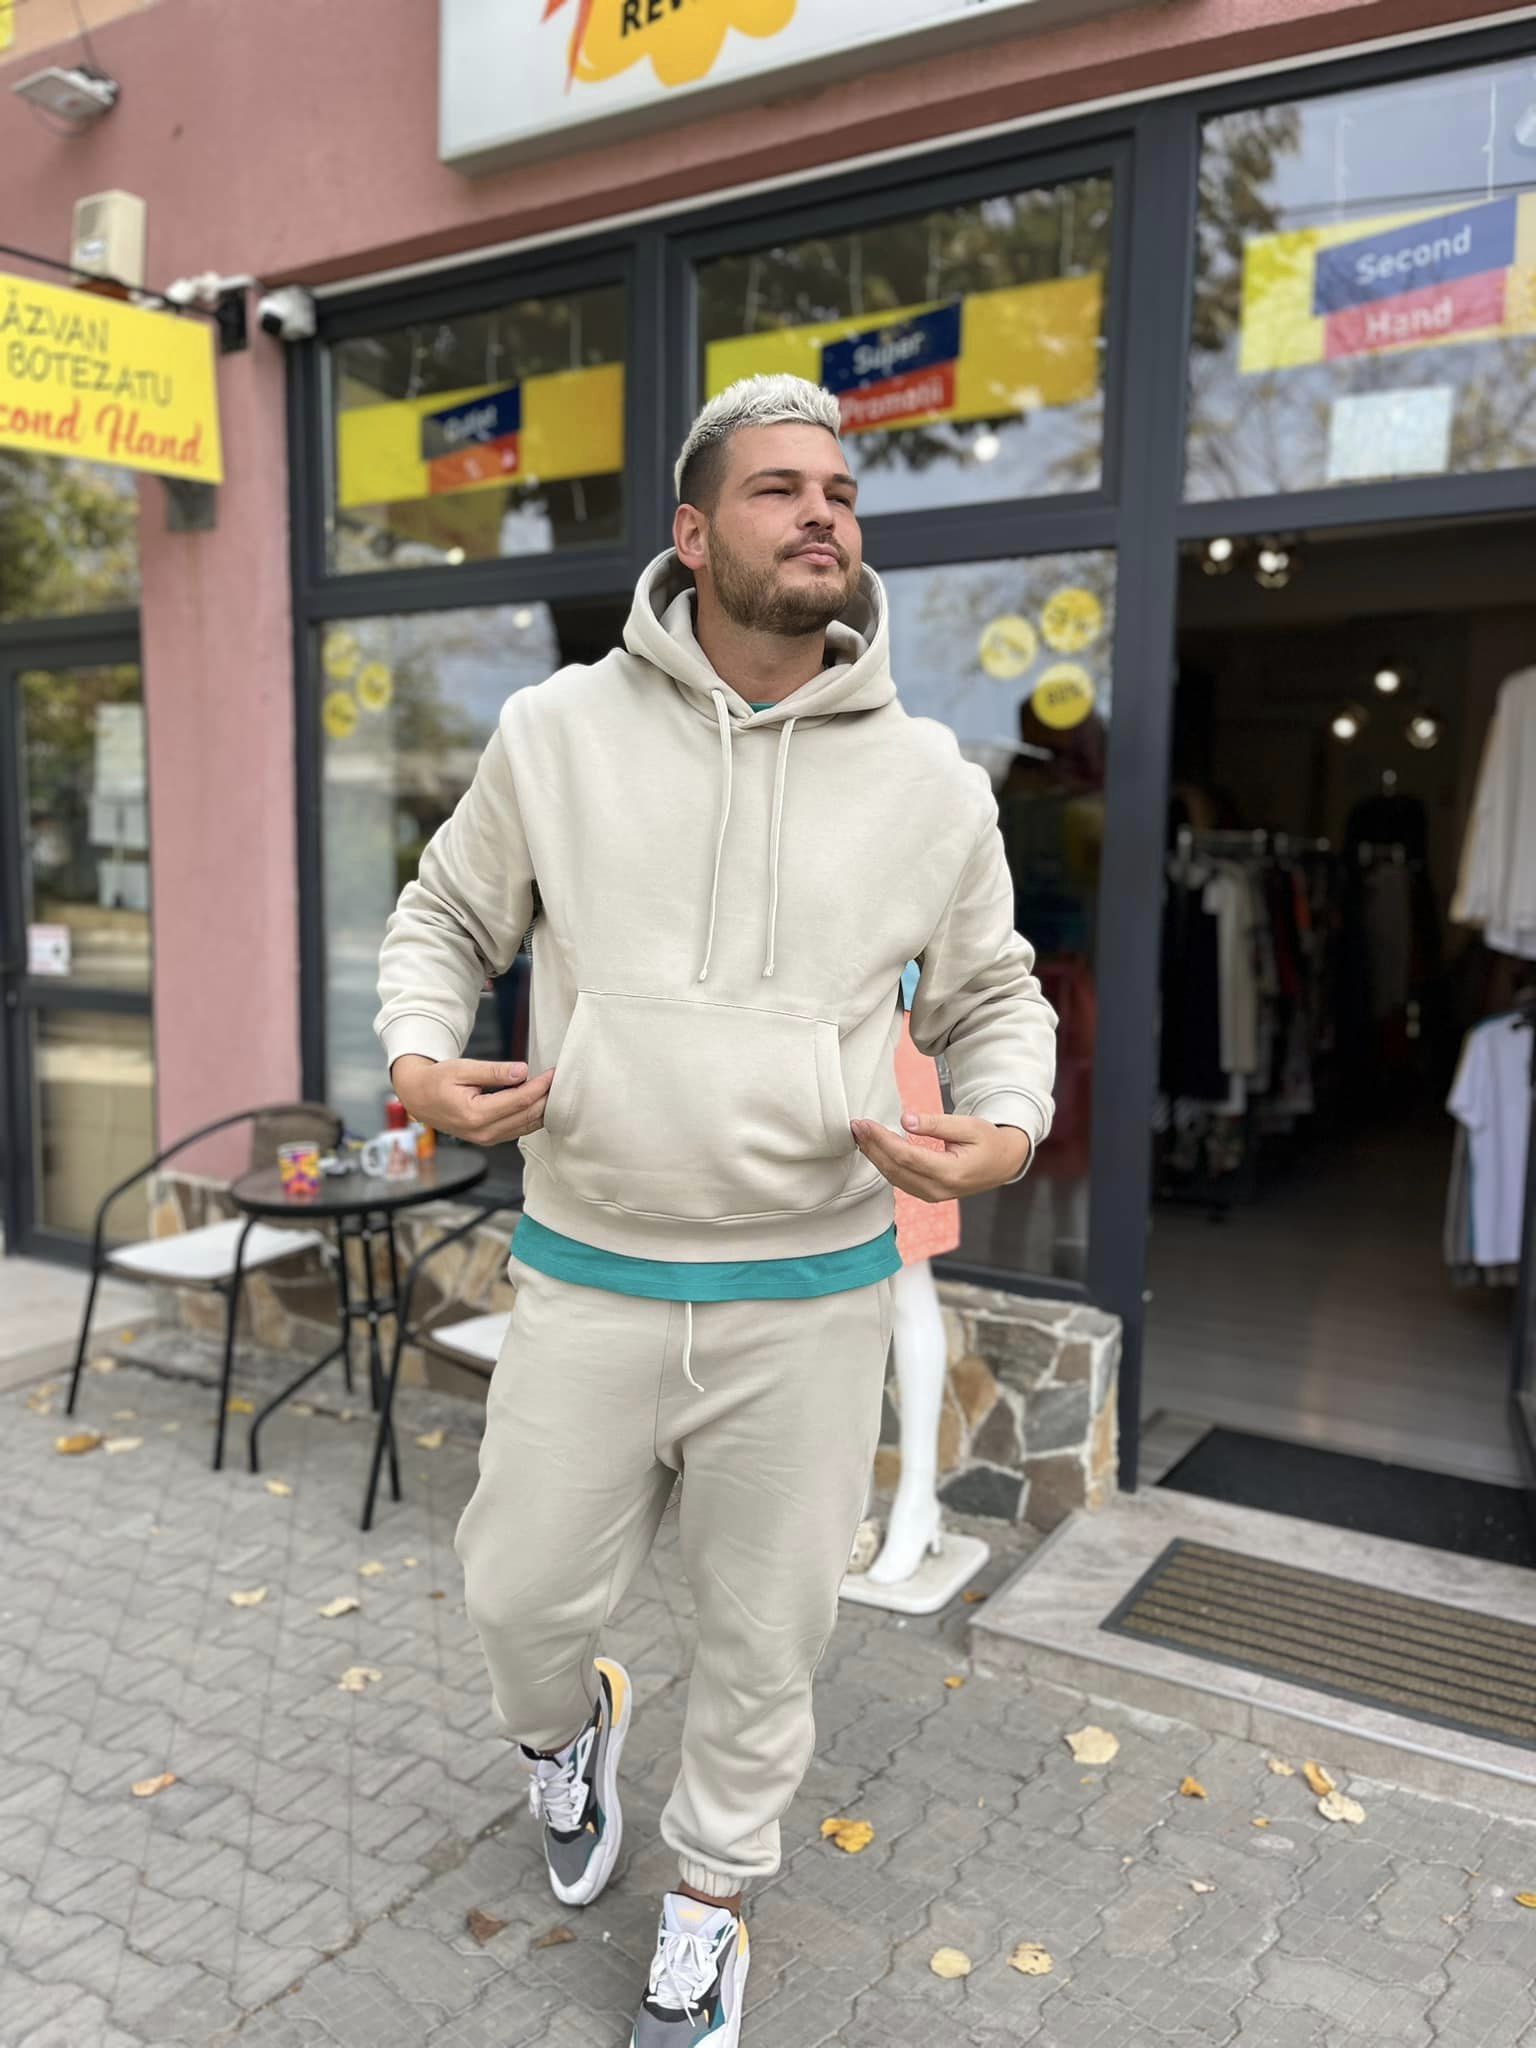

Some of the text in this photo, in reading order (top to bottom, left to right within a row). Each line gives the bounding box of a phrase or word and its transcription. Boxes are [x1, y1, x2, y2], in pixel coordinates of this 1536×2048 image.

[1355, 223, 1473, 286] Second
[1365, 296, 1454, 339] Hand
[7, 339, 174, 408] BOTEZATU
[853, 330, 927, 376] Super
